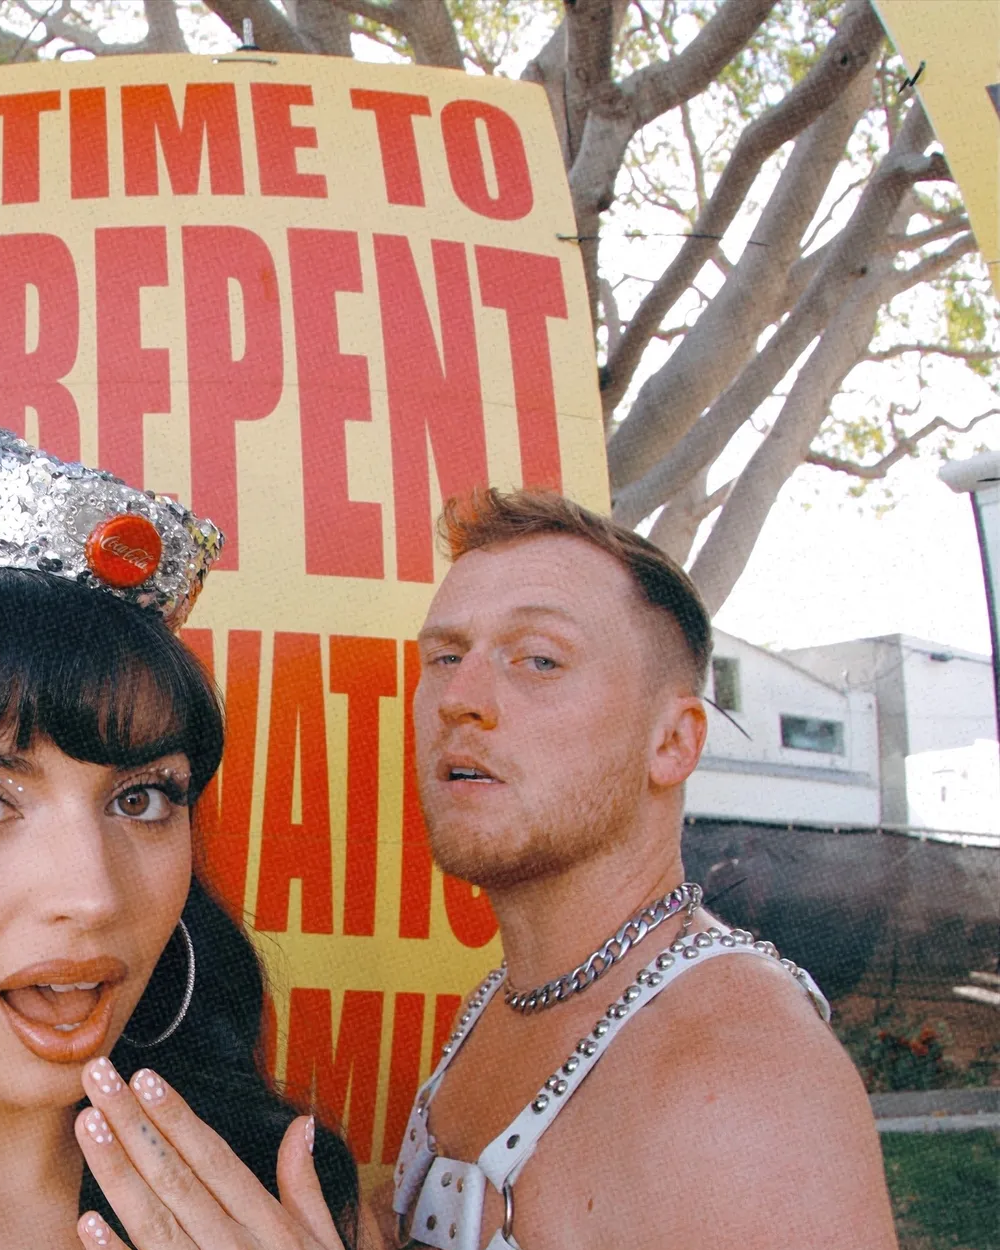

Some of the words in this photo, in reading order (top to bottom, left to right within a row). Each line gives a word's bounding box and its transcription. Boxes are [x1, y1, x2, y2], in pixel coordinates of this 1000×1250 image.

[350, 88, 534, 221] TO
[101, 535, 154, 571] Coca-Cola
[180, 627, 500, 948] VATI
